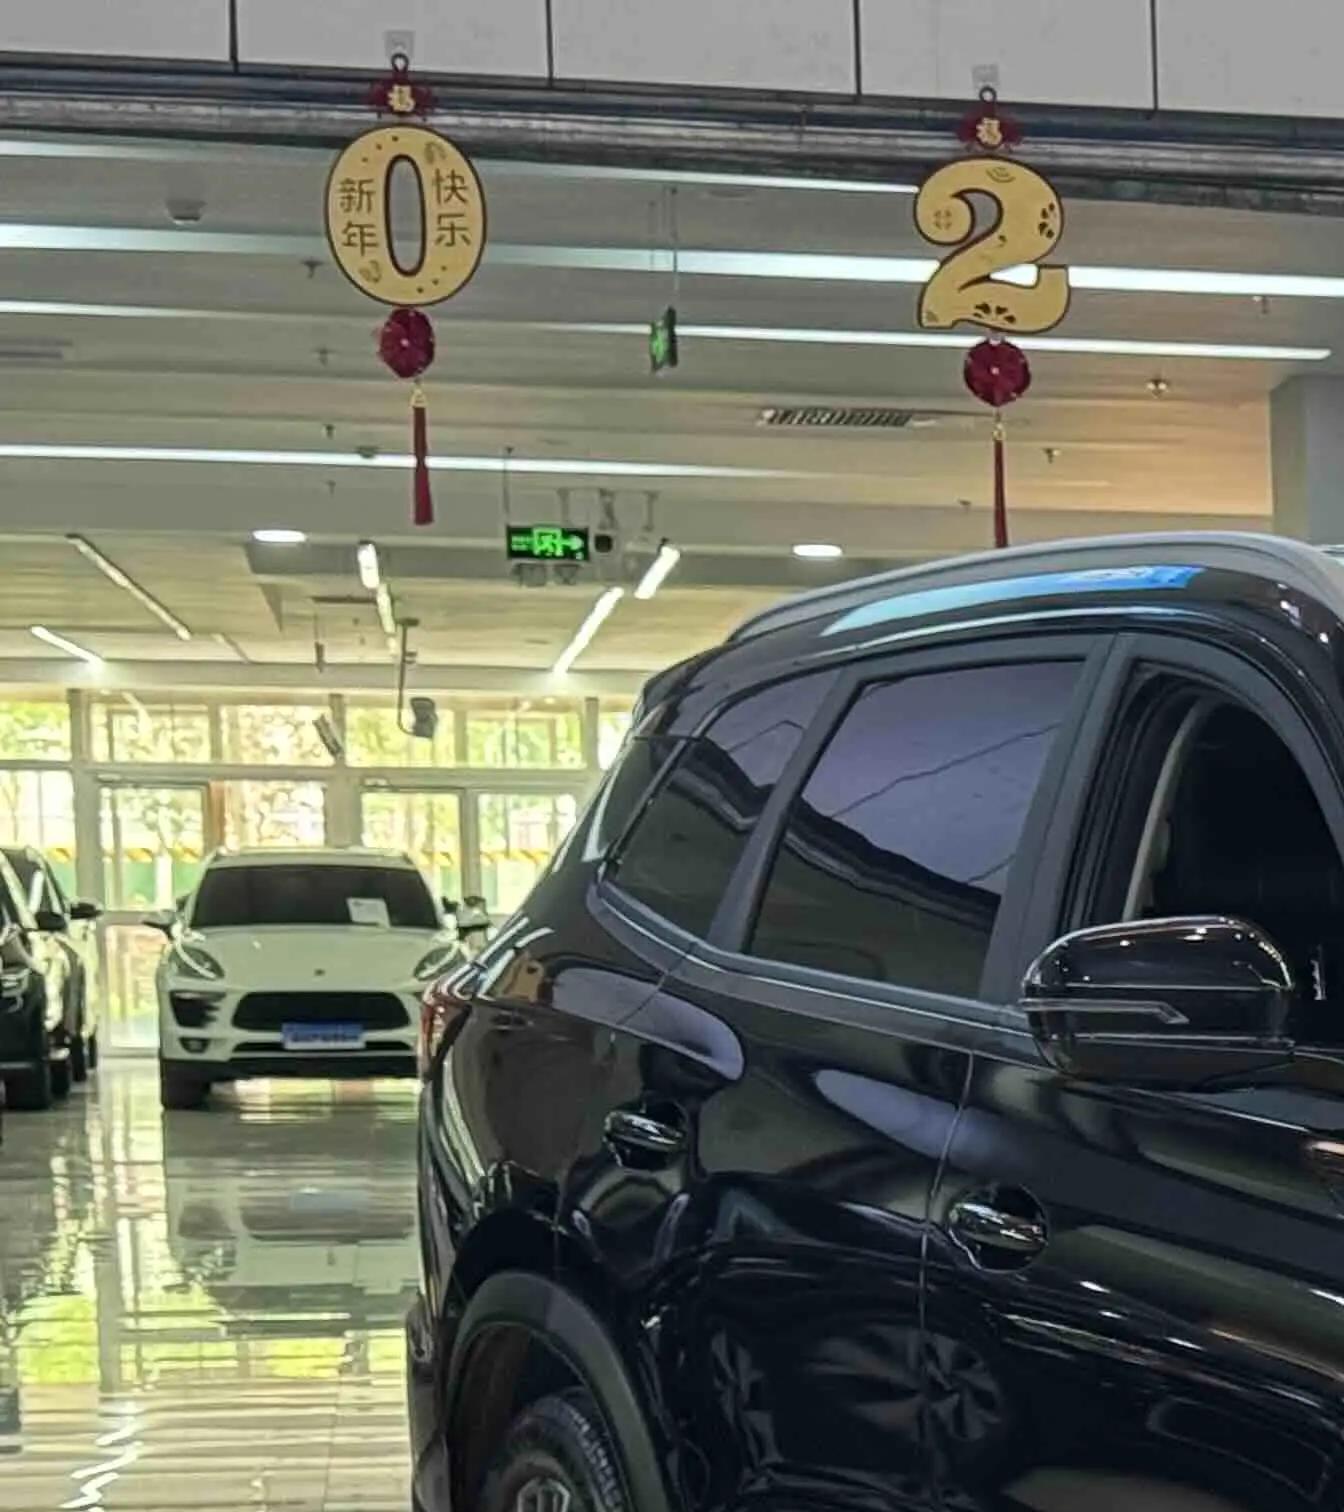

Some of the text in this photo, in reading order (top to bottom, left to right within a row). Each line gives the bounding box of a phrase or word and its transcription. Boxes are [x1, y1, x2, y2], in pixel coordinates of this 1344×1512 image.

[324, 123, 488, 307] 0
[913, 156, 1071, 335] 2
[337, 177, 379, 257] 新年
[432, 167, 472, 248] 快乐
